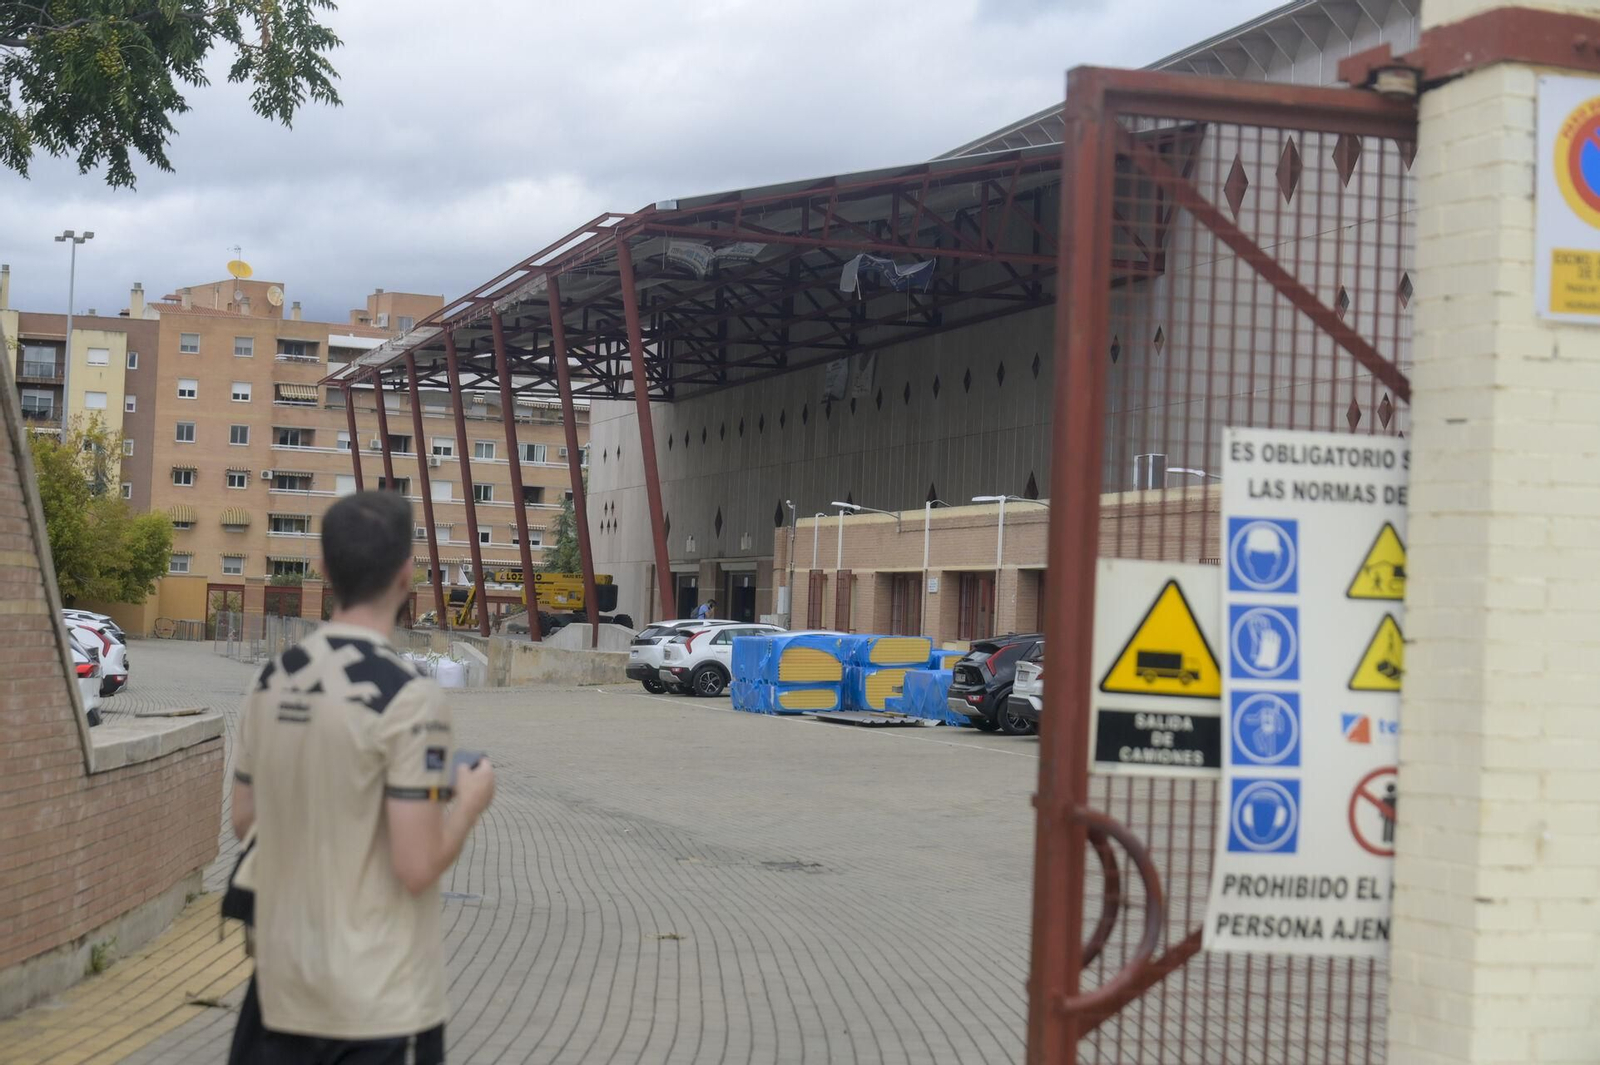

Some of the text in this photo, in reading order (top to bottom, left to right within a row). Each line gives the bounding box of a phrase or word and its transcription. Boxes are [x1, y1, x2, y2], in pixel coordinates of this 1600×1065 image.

[1231, 441, 1255, 462] ES
[1262, 443, 1395, 469] OBLIGATORIO
[1248, 478, 1408, 505] LAS NORMAS DE
[506, 573, 542, 581] LOZO
[1134, 712, 1194, 732] SALIDA
[1378, 718, 1398, 734] te
[1151, 730, 1175, 748] DE
[1118, 745, 1205, 766] CAMIONES
[1222, 873, 1348, 899] PROHIBIDO
[1356, 876, 1381, 900] EL
[1216, 913, 1391, 941] PERSONA AJEN
